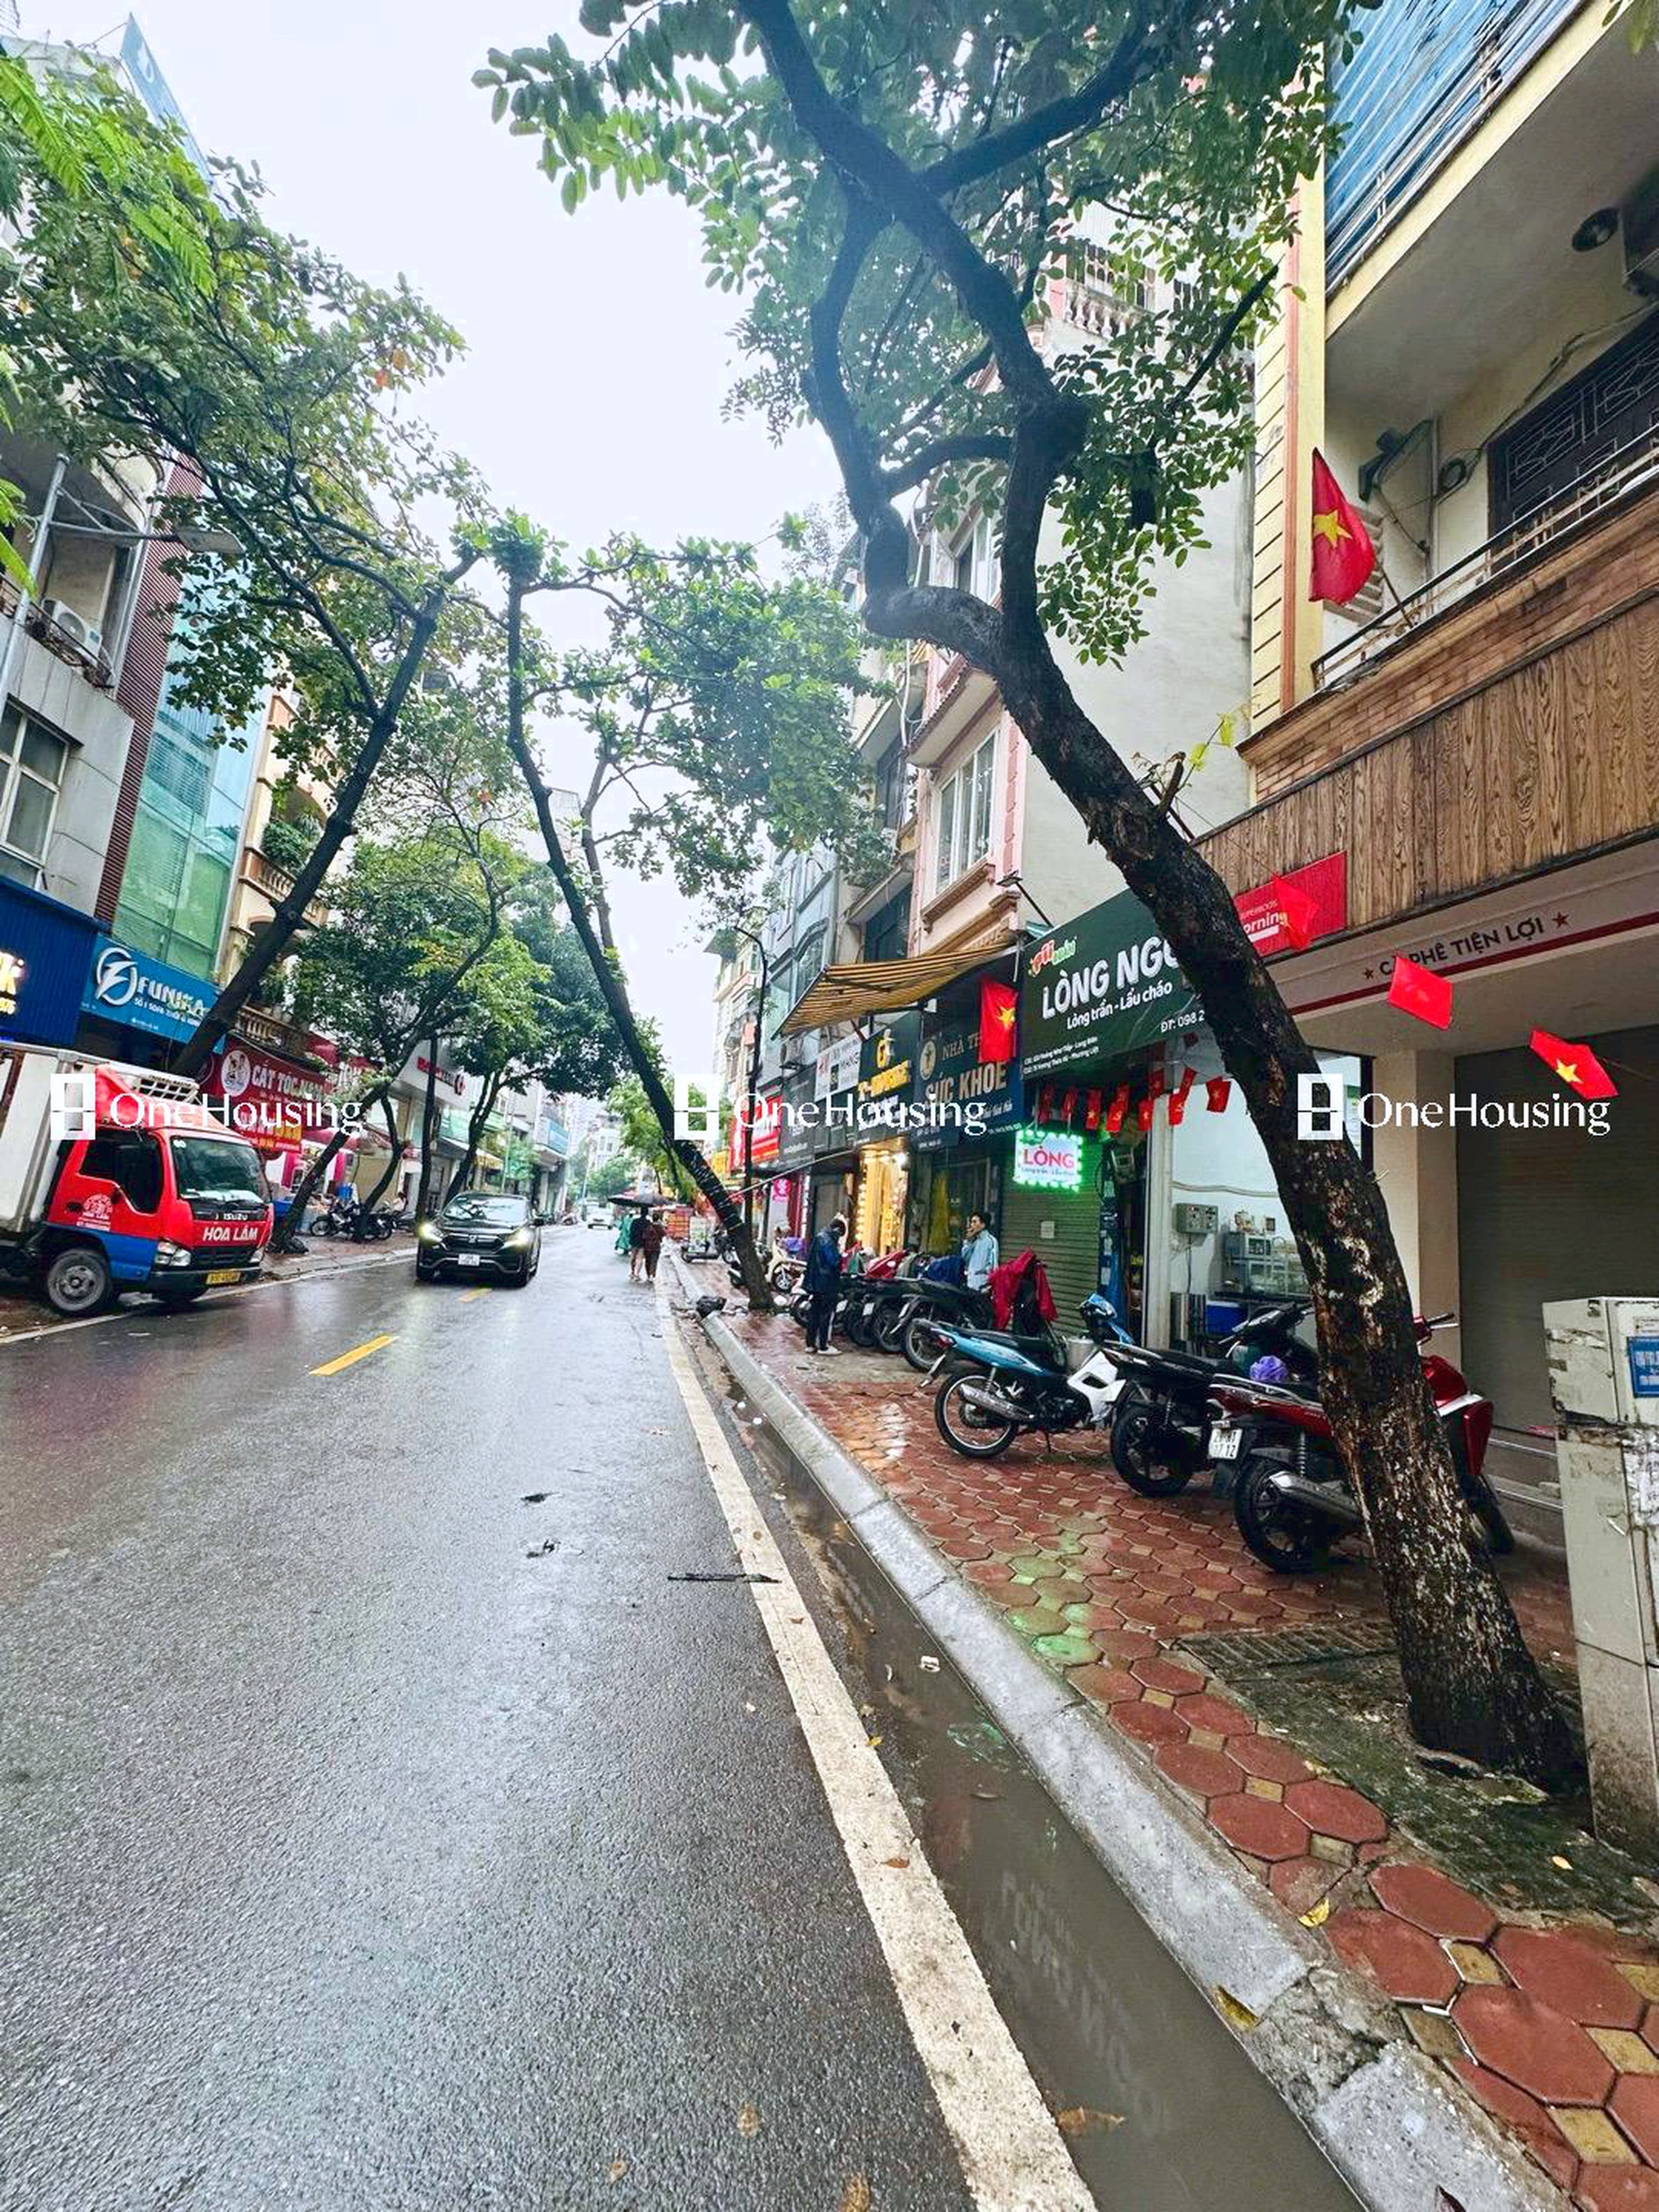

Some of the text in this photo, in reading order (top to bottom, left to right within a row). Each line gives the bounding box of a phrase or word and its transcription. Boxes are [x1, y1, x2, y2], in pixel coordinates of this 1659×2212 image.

[1409, 943, 1448, 965] PHÊ
[1450, 929, 1501, 955] TIỆN
[1505, 917, 1544, 941] LỢI
[1042, 968, 1110, 1020] LÒNG
[1117, 936, 1180, 990] NGO
[1067, 1010, 1091, 1030] Lòng
[1120, 987, 1142, 1010] Lẩu
[1142, 979, 1173, 1004] cháo
[203, 1226, 230, 1241] HOA
